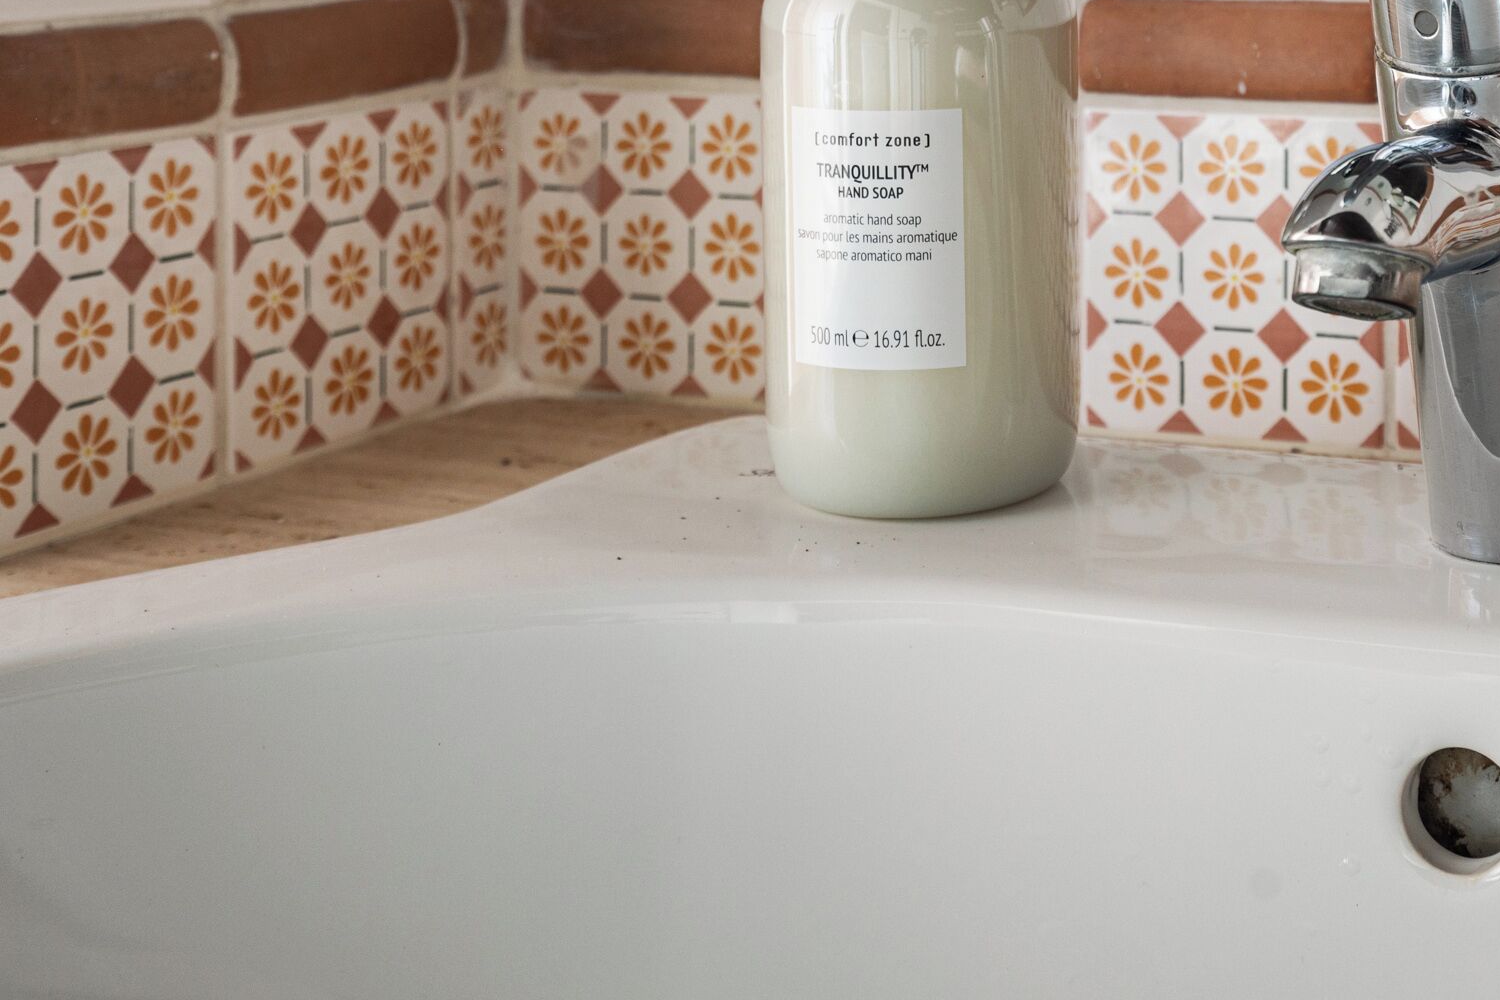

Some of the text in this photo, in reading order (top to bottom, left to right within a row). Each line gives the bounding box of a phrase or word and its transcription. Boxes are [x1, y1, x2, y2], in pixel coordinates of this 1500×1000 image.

[838, 186, 904, 199] HAND SOAP
[823, 213, 922, 228] aromatic hand soap
[797, 229, 958, 245] savon pour les mains aromatique
[816, 248, 932, 263] sapone aromatico mani
[810, 326, 831, 346] 500
[834, 327, 849, 347] ml
[873, 330, 910, 348] 16.91
[915, 329, 946, 348] fl.oz.
